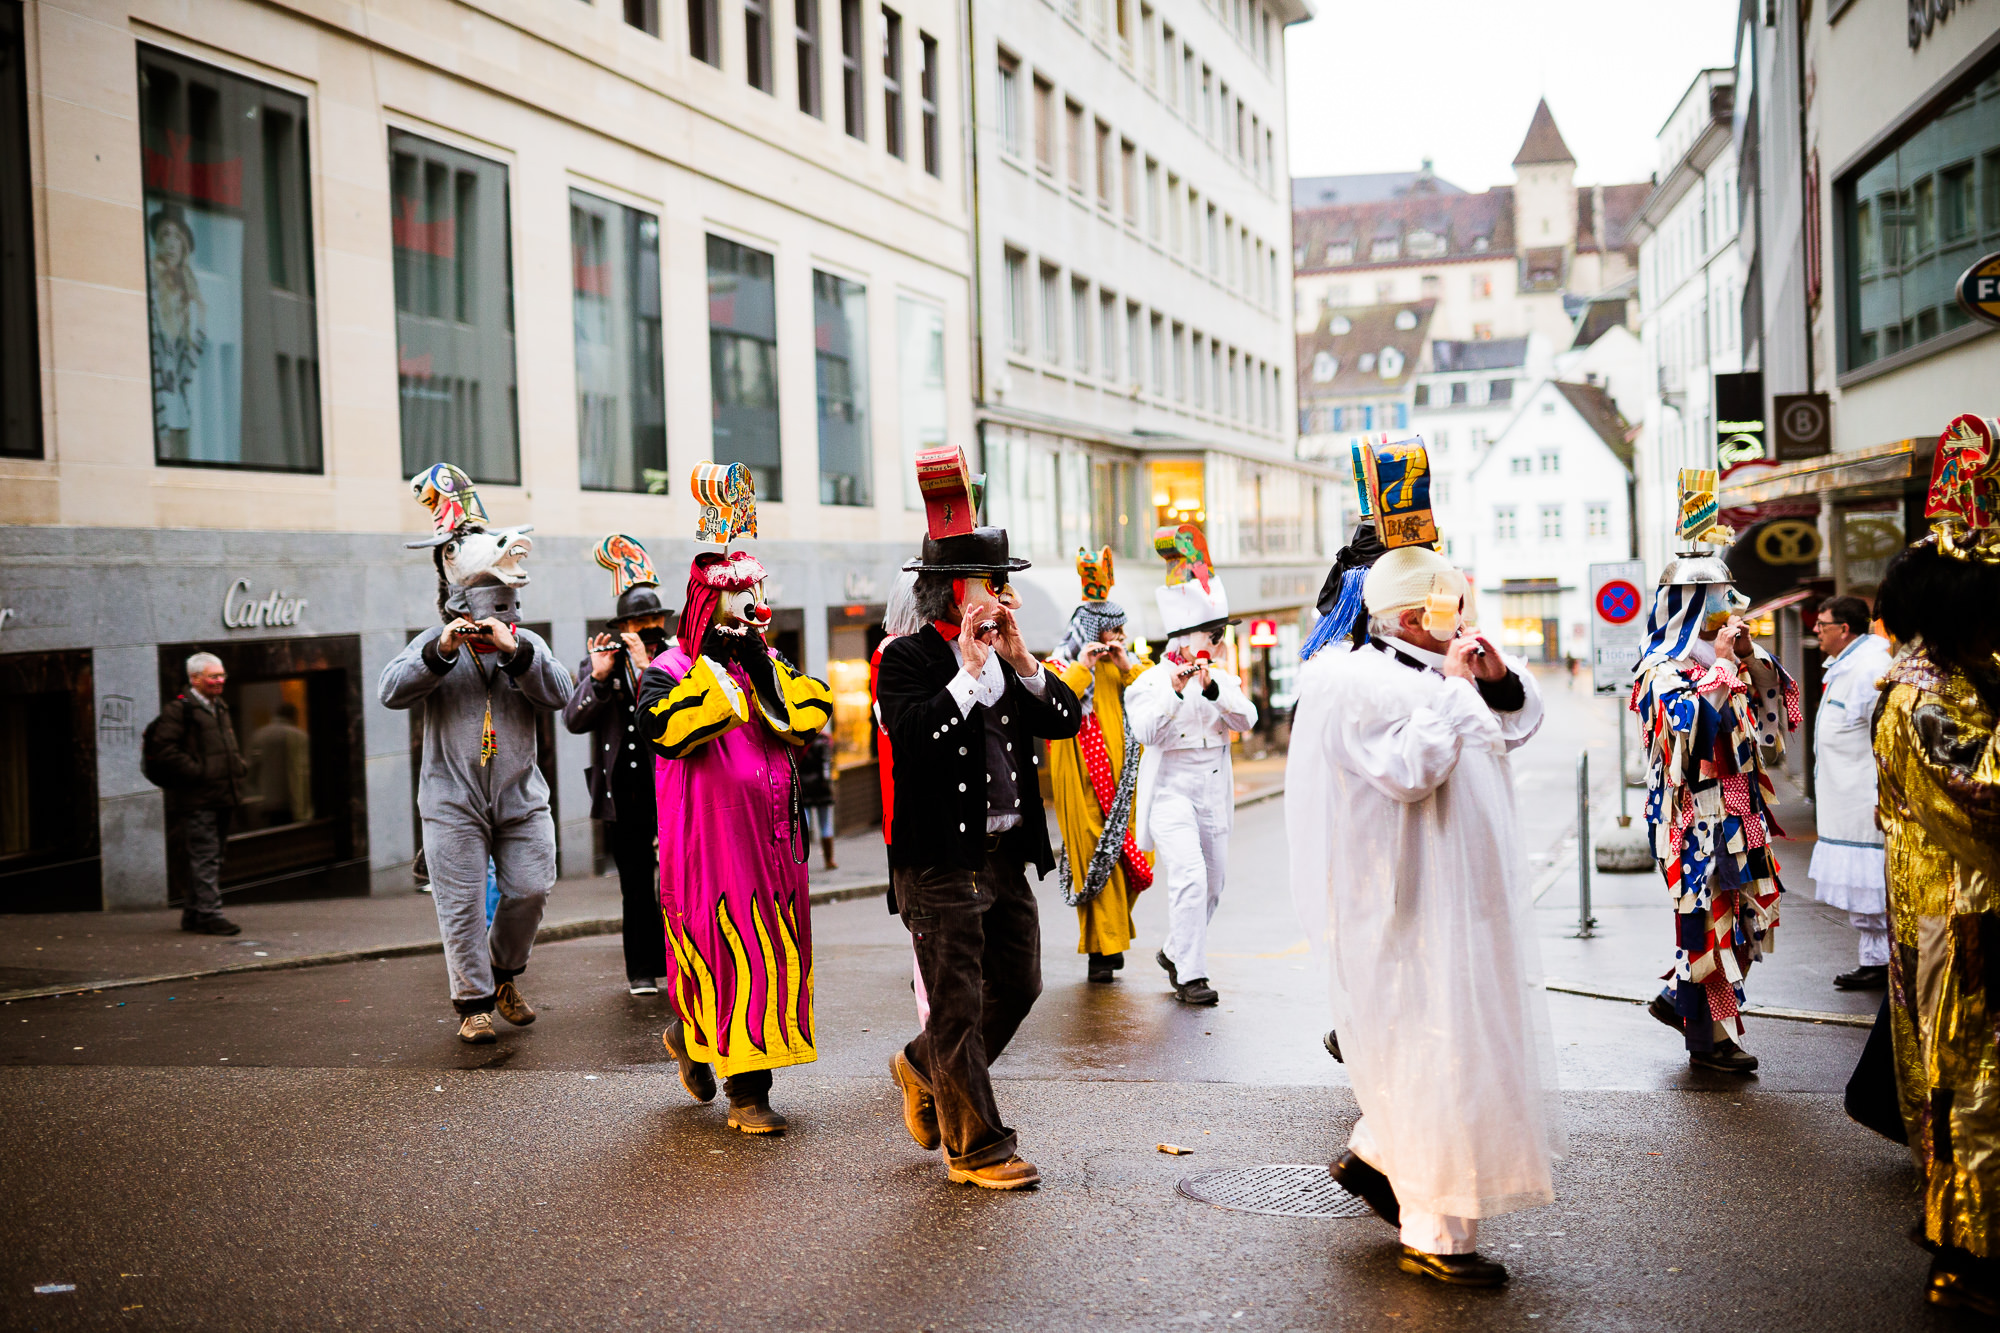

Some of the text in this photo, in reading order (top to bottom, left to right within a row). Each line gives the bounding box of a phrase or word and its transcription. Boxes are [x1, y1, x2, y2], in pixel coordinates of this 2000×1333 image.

[1796, 409, 1812, 434] B
[1685, 494, 1717, 524] BMG
[222, 576, 309, 629] Cartier
